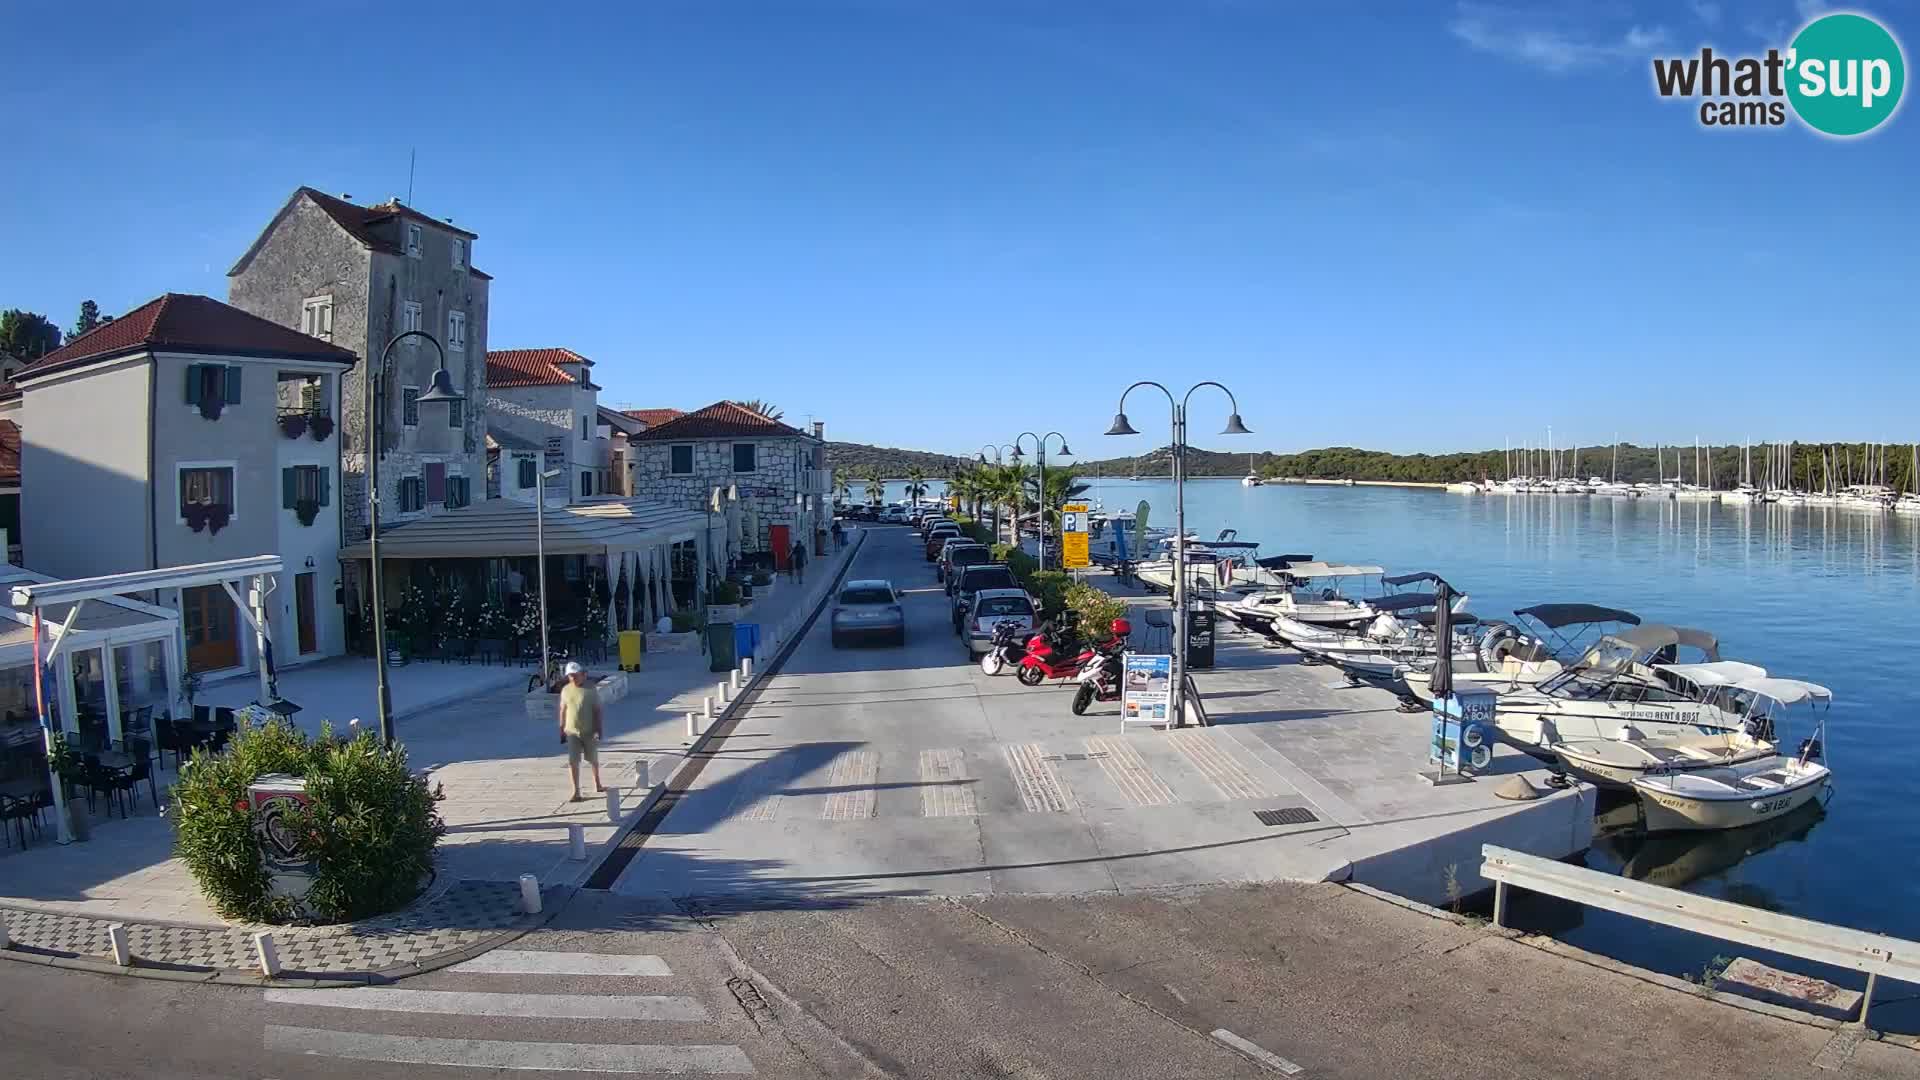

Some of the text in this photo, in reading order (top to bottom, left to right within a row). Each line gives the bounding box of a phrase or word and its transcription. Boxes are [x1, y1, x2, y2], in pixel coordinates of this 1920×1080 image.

[1463, 703, 1494, 712] RENT
[1462, 711, 1494, 721] A BOAT
[1655, 711, 1673, 720] RENT
[1675, 712, 1680, 722] A
[1681, 712, 1699, 723] BOAT
